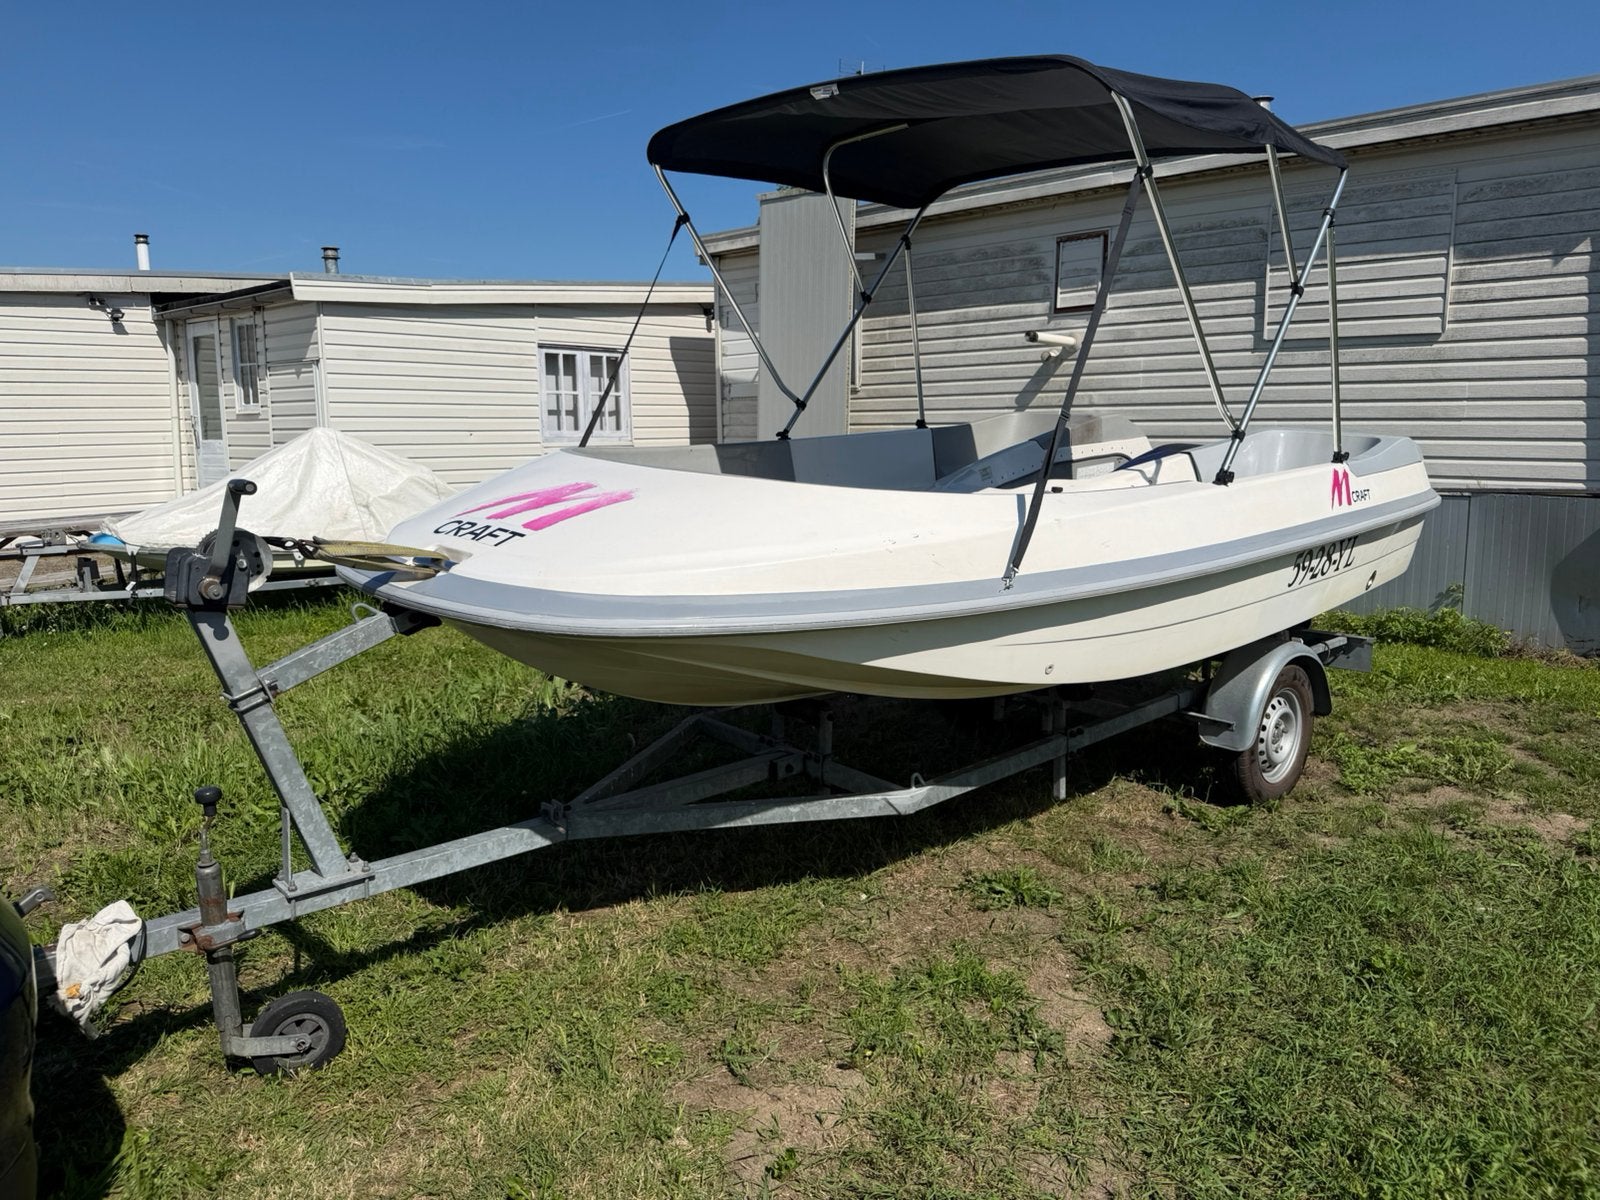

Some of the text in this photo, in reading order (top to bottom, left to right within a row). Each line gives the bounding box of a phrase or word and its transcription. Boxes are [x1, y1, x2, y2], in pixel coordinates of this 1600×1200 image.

[1331, 468, 1370, 509] M CRAFT
[433, 520, 526, 547] CRAFT
